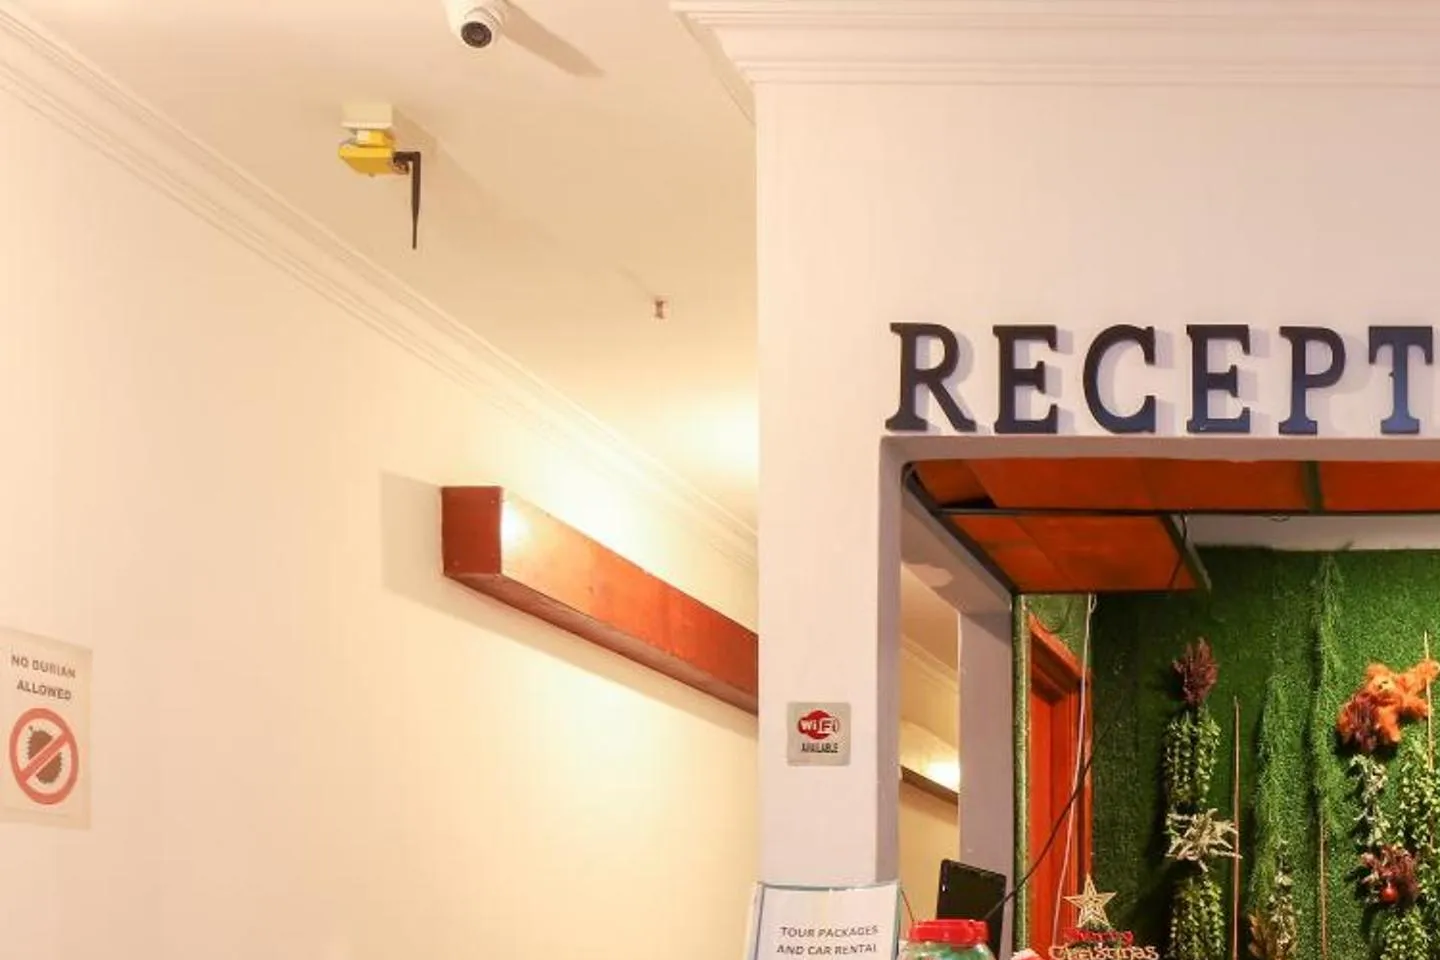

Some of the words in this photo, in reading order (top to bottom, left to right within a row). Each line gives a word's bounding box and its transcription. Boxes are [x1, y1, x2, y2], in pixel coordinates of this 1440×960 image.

[11, 654, 29, 668] NO
[32, 660, 76, 679] DURIAN
[17, 679, 71, 701] ALLOWED
[780, 926, 815, 938] TOUR
[817, 925, 879, 938] PACKAGES
[776, 945, 804, 955] AND
[807, 946, 832, 955] CAR
